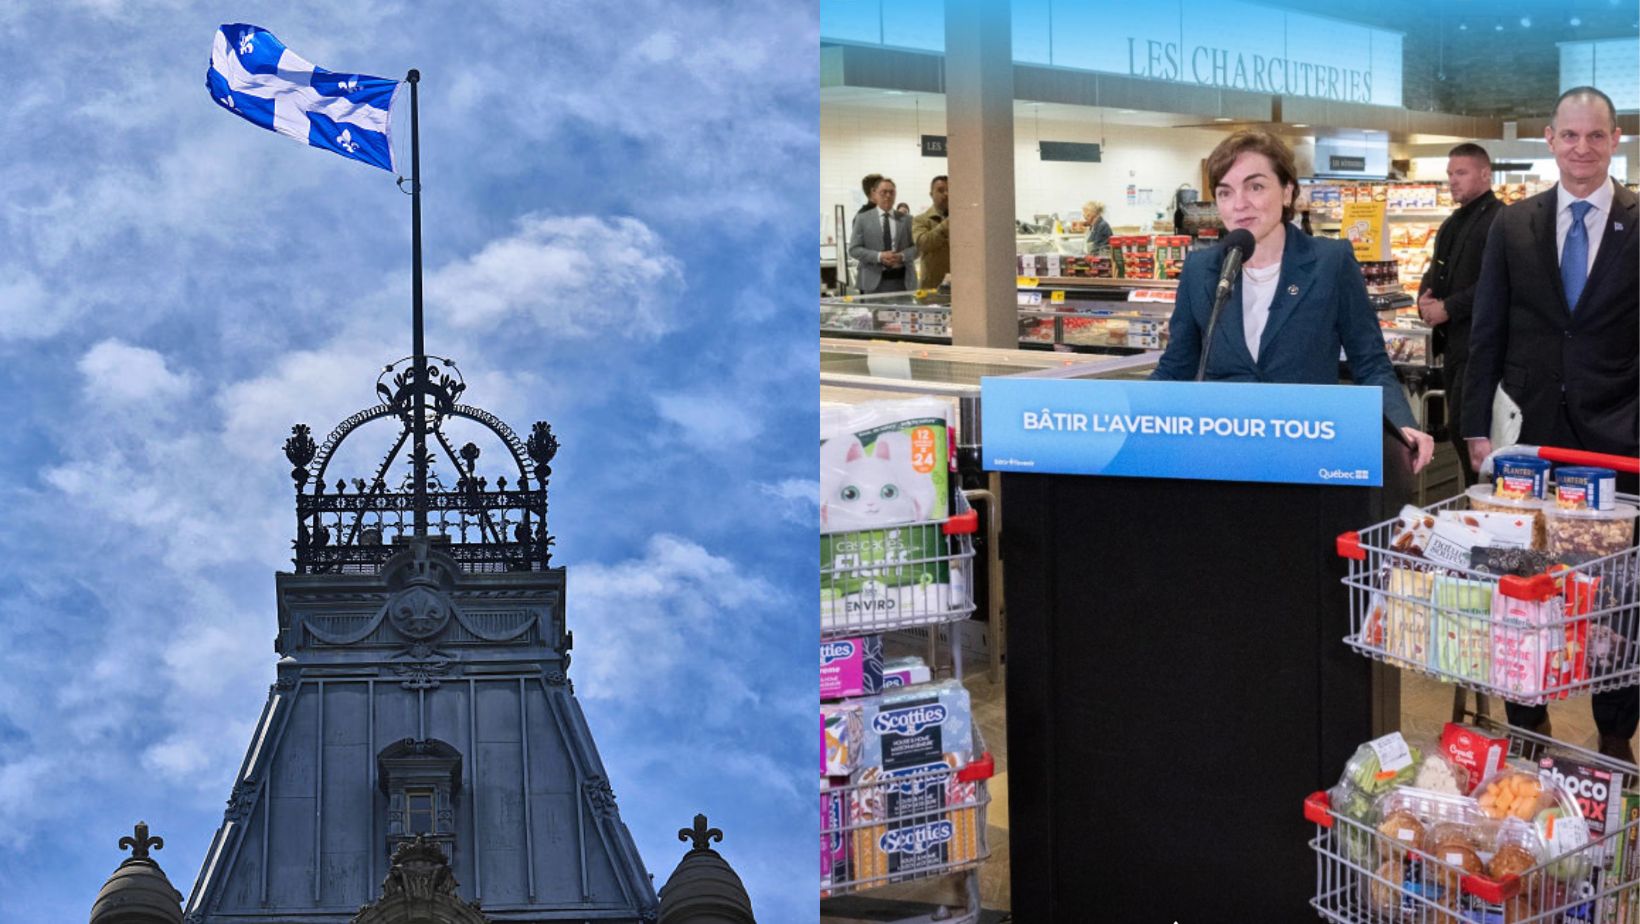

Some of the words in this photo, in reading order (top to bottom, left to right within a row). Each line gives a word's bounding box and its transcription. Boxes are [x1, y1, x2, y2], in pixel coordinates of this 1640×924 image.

[1127, 37, 1178, 82] LES
[1191, 45, 1373, 104] CHARCUTERIES
[927, 141, 942, 152] LES
[1023, 408, 1087, 432] BÂTIR
[1092, 414, 1193, 436] L'AVENIR
[1199, 417, 1266, 438] POUR
[1270, 419, 1336, 440] TOUS
[917, 429, 929, 440] 12
[913, 453, 934, 466] 24
[1318, 468, 1355, 480] Québec
[846, 599, 896, 612] ENVIRO
[876, 707, 943, 732] Scotties
[1539, 766, 1608, 801] choco
[883, 824, 950, 852] Scotties
